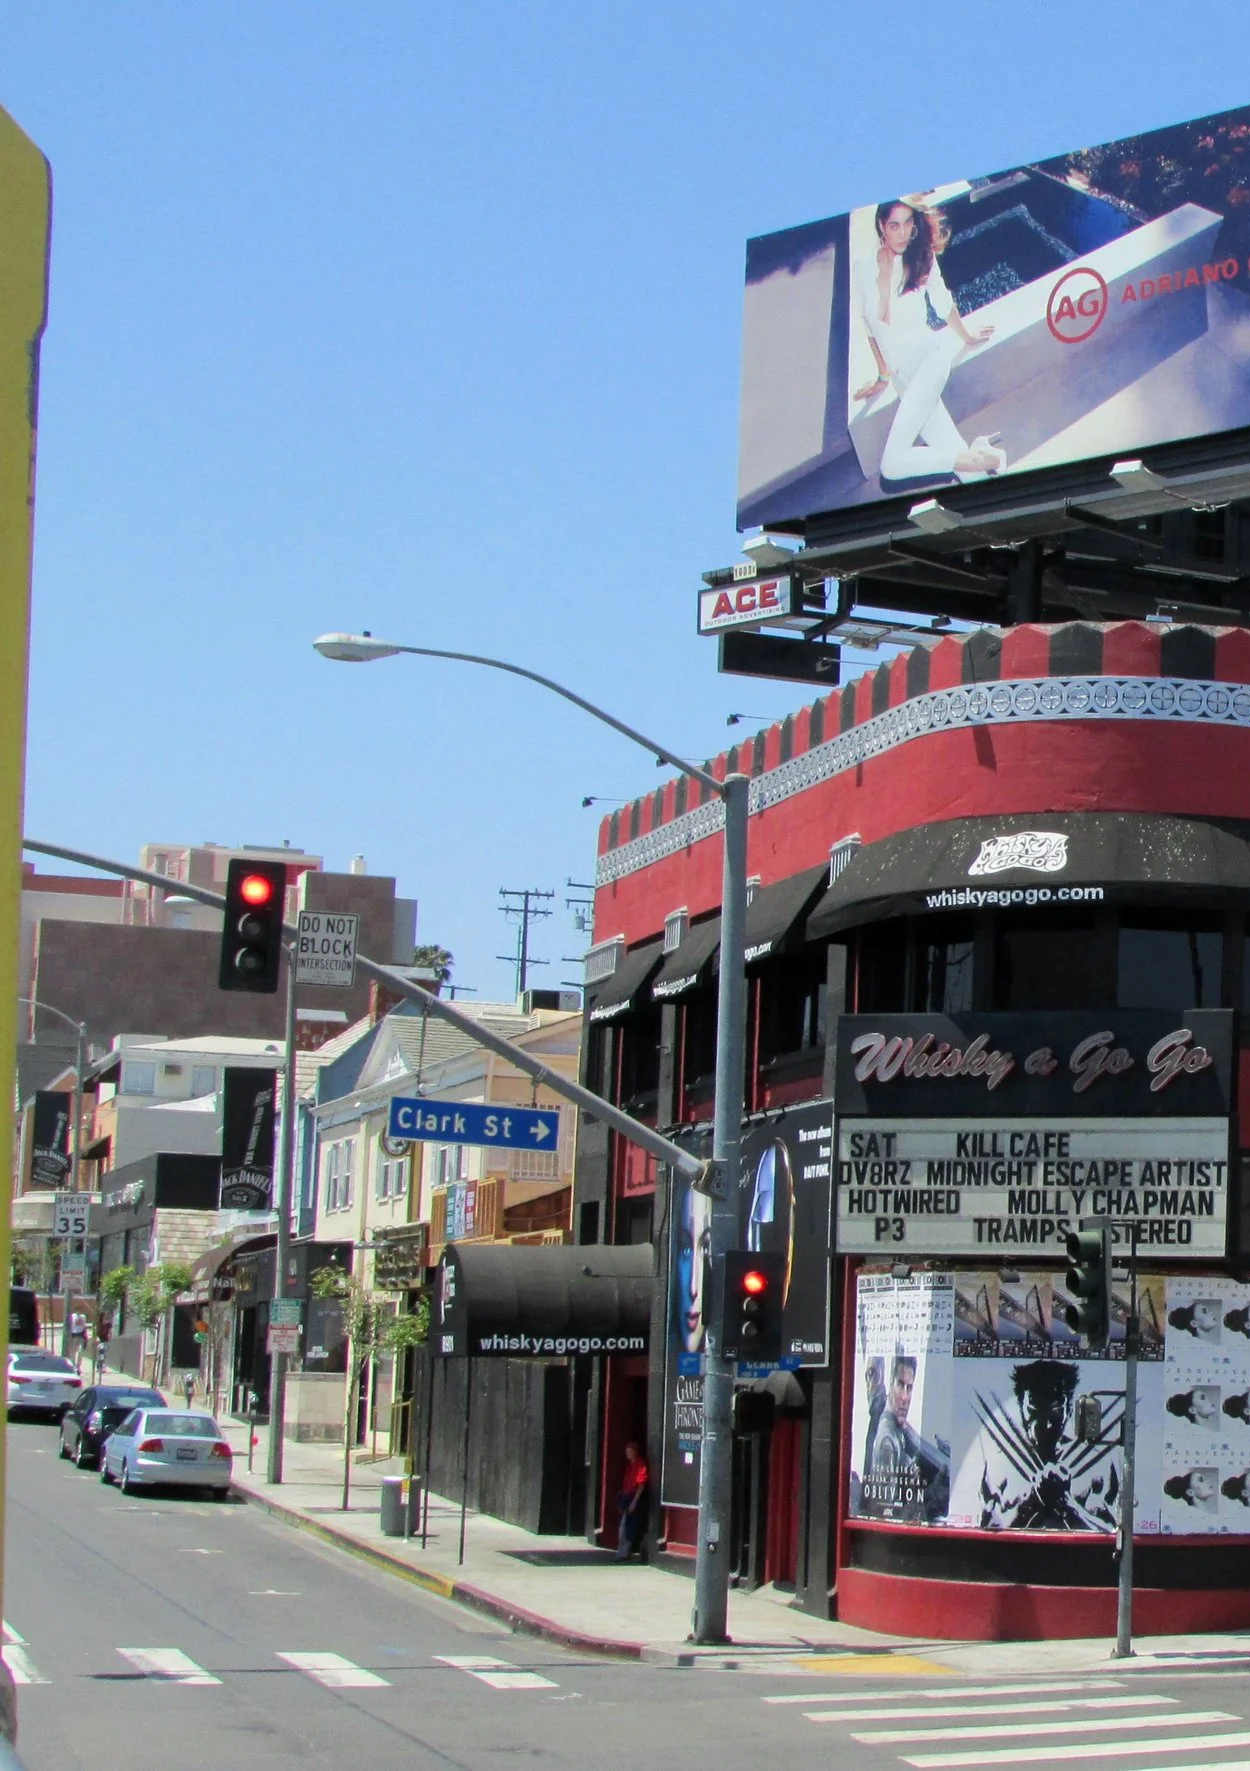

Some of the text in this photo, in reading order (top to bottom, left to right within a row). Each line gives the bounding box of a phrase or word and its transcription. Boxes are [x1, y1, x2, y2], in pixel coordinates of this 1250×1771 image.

[1054, 288, 1100, 323] AG
[1121, 257, 1239, 304] ADRIANO
[711, 582, 779, 619] ACE
[926, 884, 1104, 908] whiskyagogo.com
[301, 916, 355, 934] DO NOT
[300, 937, 352, 956] BLOCK
[851, 1031, 1015, 1091] Whisky
[1069, 1030, 1134, 1093] Go
[1147, 1028, 1213, 1092] Go
[397, 1106, 512, 1138] Clark St
[849, 1132, 1071, 1159] SAT KILL CAFE
[926, 1161, 1037, 1187] MIDNIGHT
[1043, 1161, 1132, 1187] ESCAPE
[1139, 1161, 1226, 1187] ARTIST
[57, 1196, 89, 1204] SPEED
[848, 1189, 1214, 1216] HOTWIRED MOLLY CHAPMAN
[58, 1217, 86, 1234] 35
[874, 1217, 906, 1242] P3
[972, 1217, 1071, 1244] TRAMPS
[480, 1334, 644, 1354] whiskyagogo.com
[864, 1483, 925, 1503] OBLIVION
